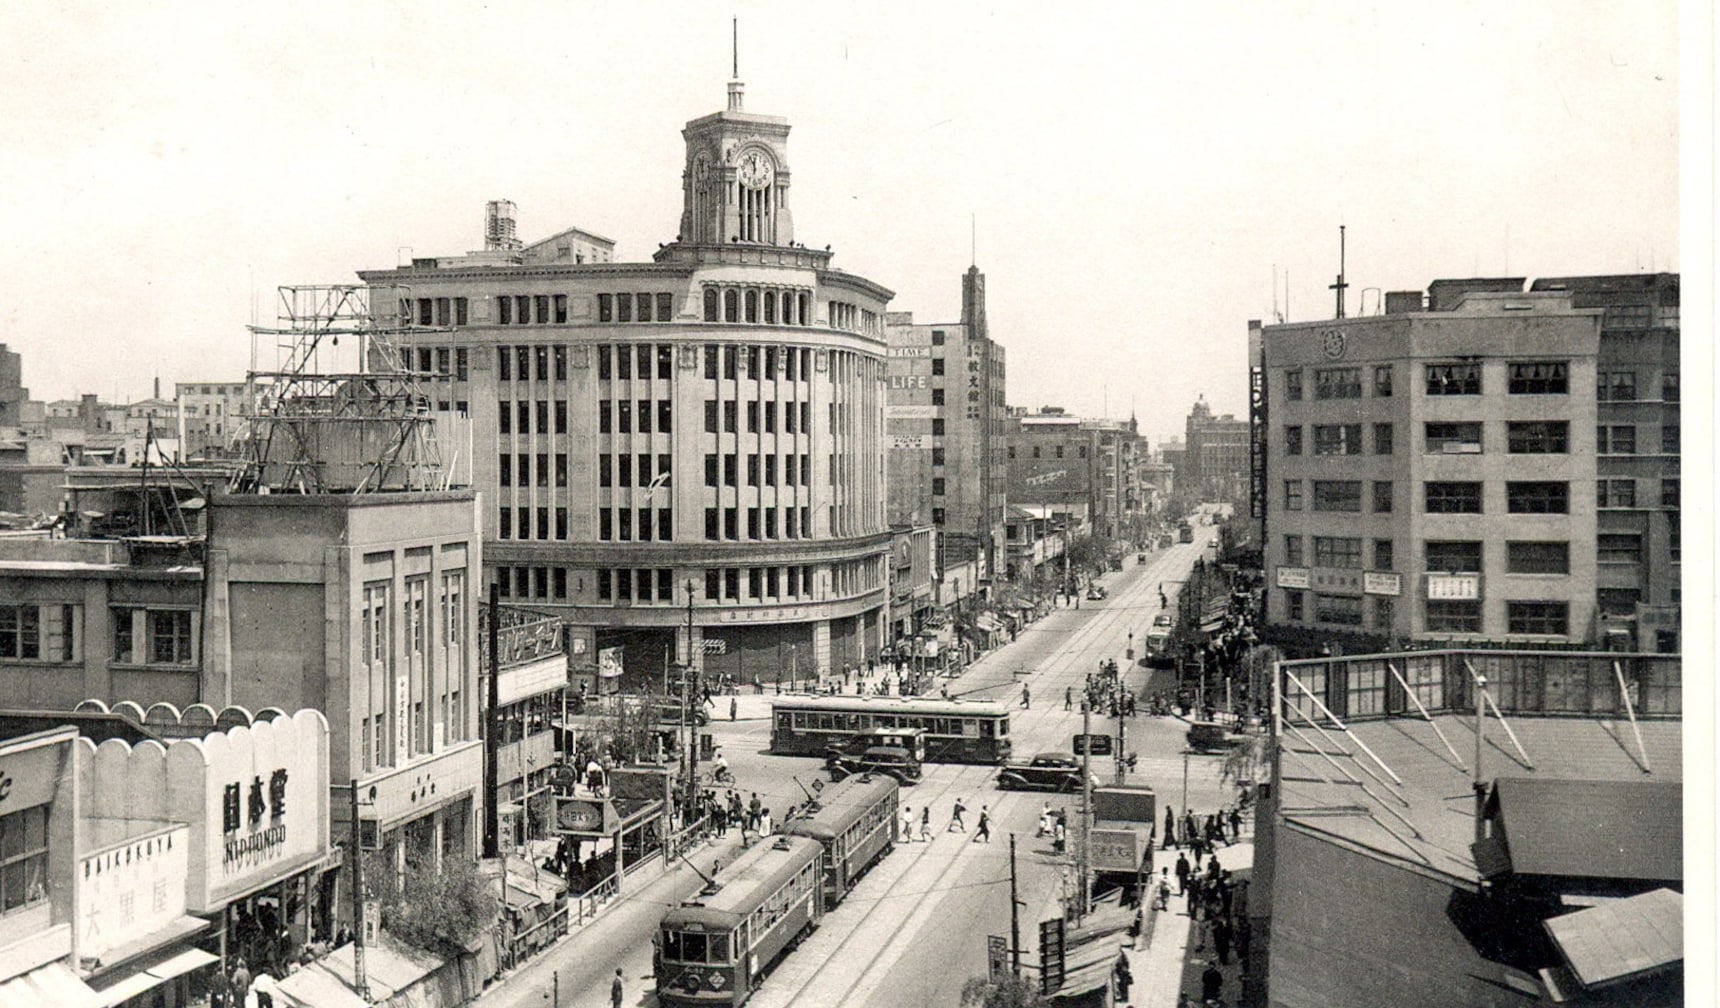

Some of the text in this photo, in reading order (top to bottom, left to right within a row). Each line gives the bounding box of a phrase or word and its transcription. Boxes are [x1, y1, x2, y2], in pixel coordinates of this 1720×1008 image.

[895, 348, 923, 357] TIME
[892, 376, 926, 389] LIFE
[223, 768, 288, 833] 日本堂
[85, 832, 172, 881] DAIKOKUYA
[224, 824, 286, 865] NIPPONDO
